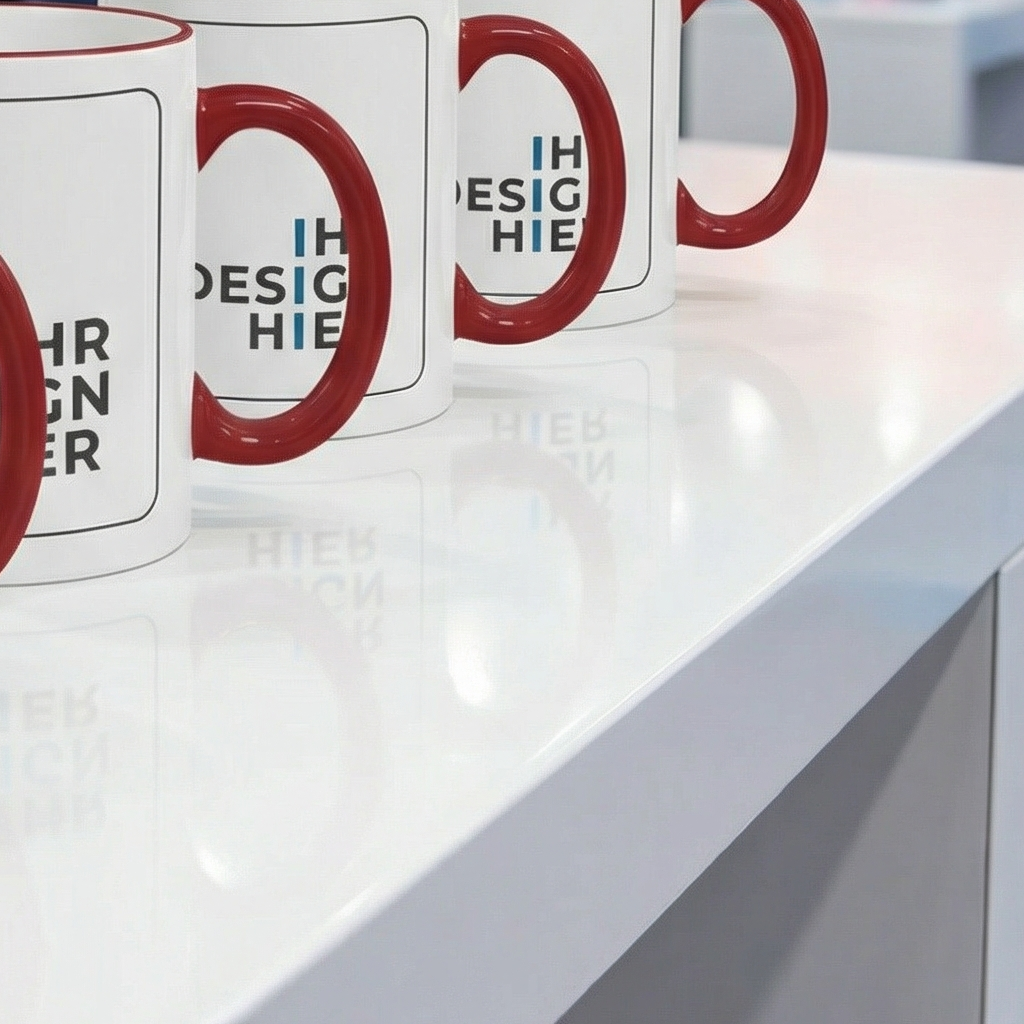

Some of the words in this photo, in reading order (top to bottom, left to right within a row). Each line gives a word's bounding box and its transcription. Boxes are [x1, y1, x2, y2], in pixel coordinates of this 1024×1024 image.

[532, 135, 582, 170] IH
[456, 177, 581, 213] ESIG
[295, 218, 348, 257] IH
[492, 218, 586, 252] HIE
[195, 262, 347, 305] DESIG
[38, 317, 110, 367] HR
[249, 311, 342, 349] HIE
